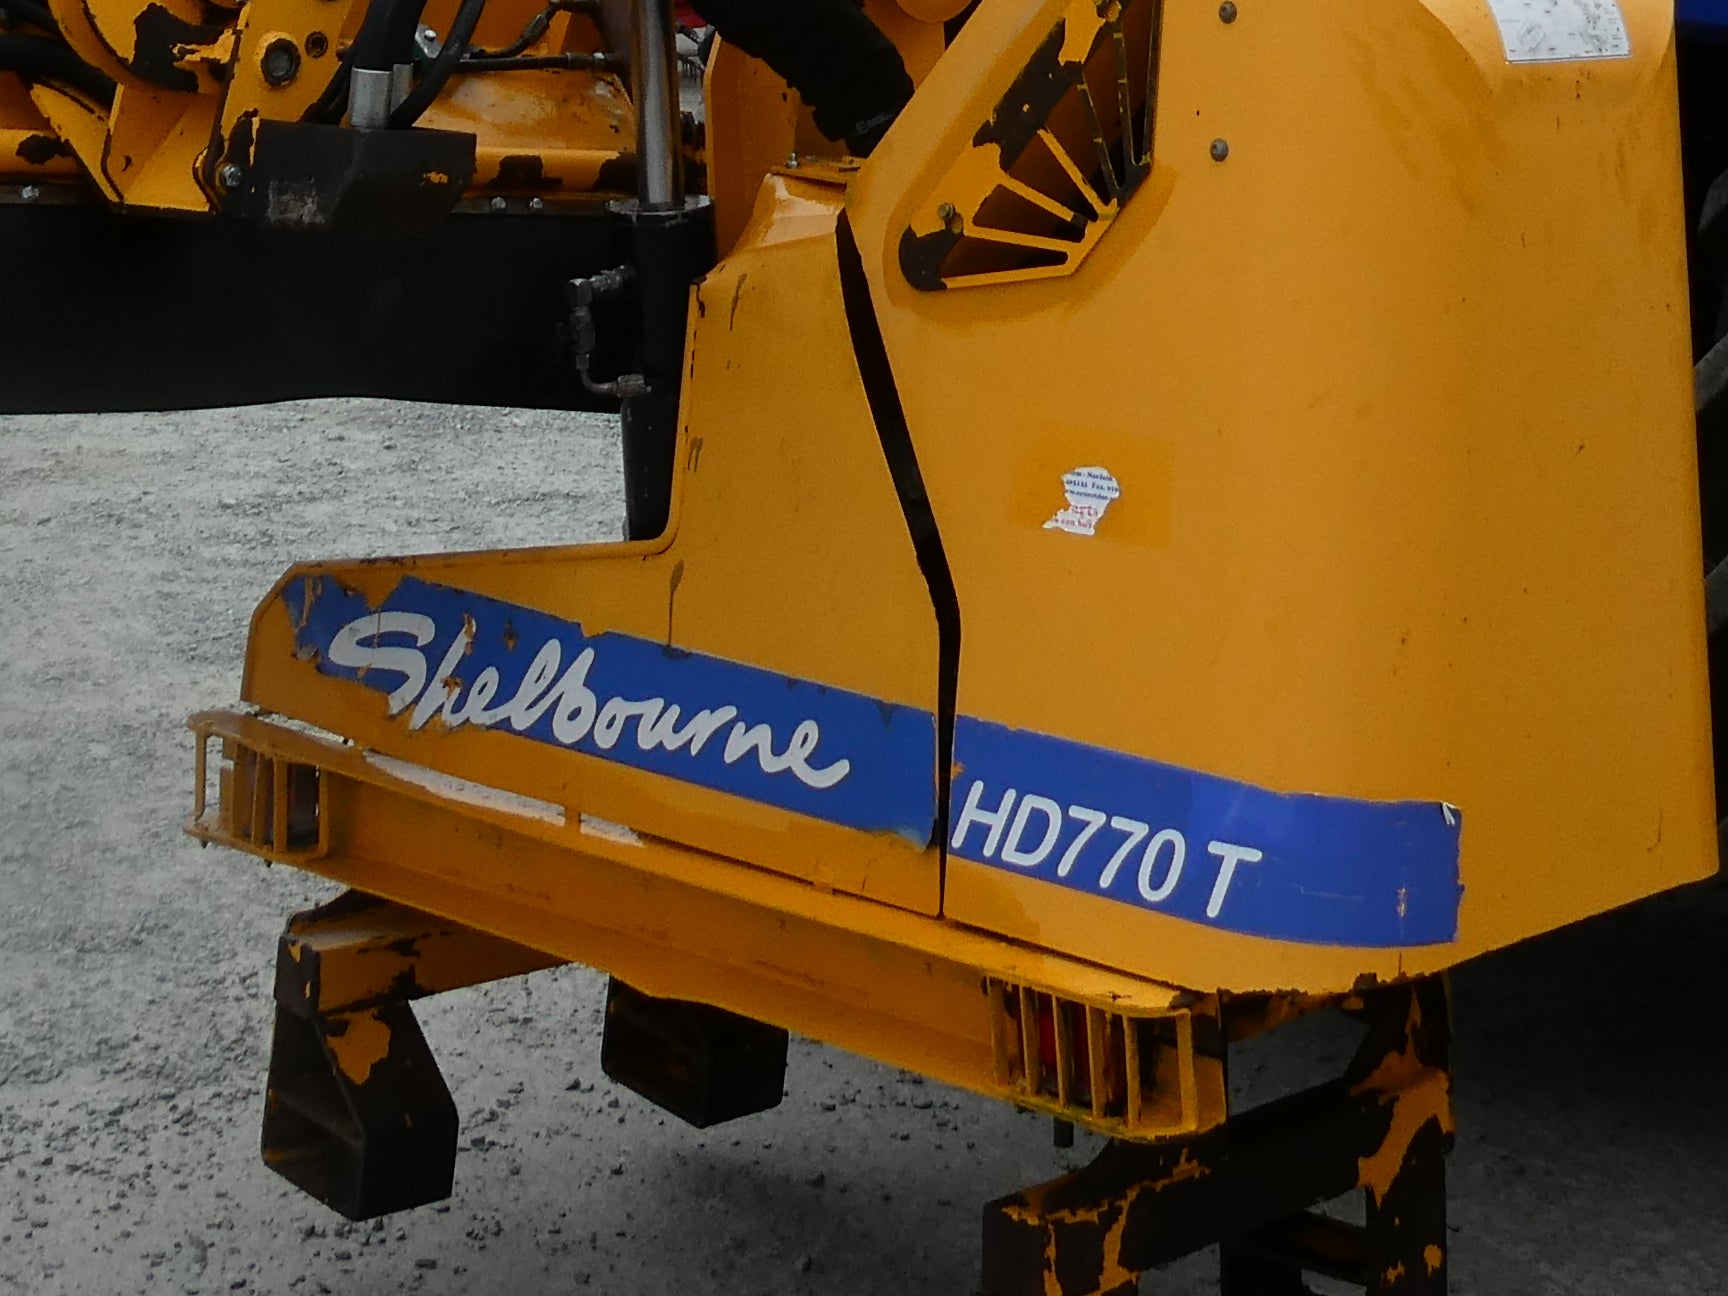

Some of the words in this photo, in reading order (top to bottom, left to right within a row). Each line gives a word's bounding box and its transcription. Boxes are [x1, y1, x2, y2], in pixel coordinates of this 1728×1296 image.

[328, 611, 851, 789] Shelbourne
[951, 779, 1186, 902] HD770
[1206, 840, 1263, 918] T
